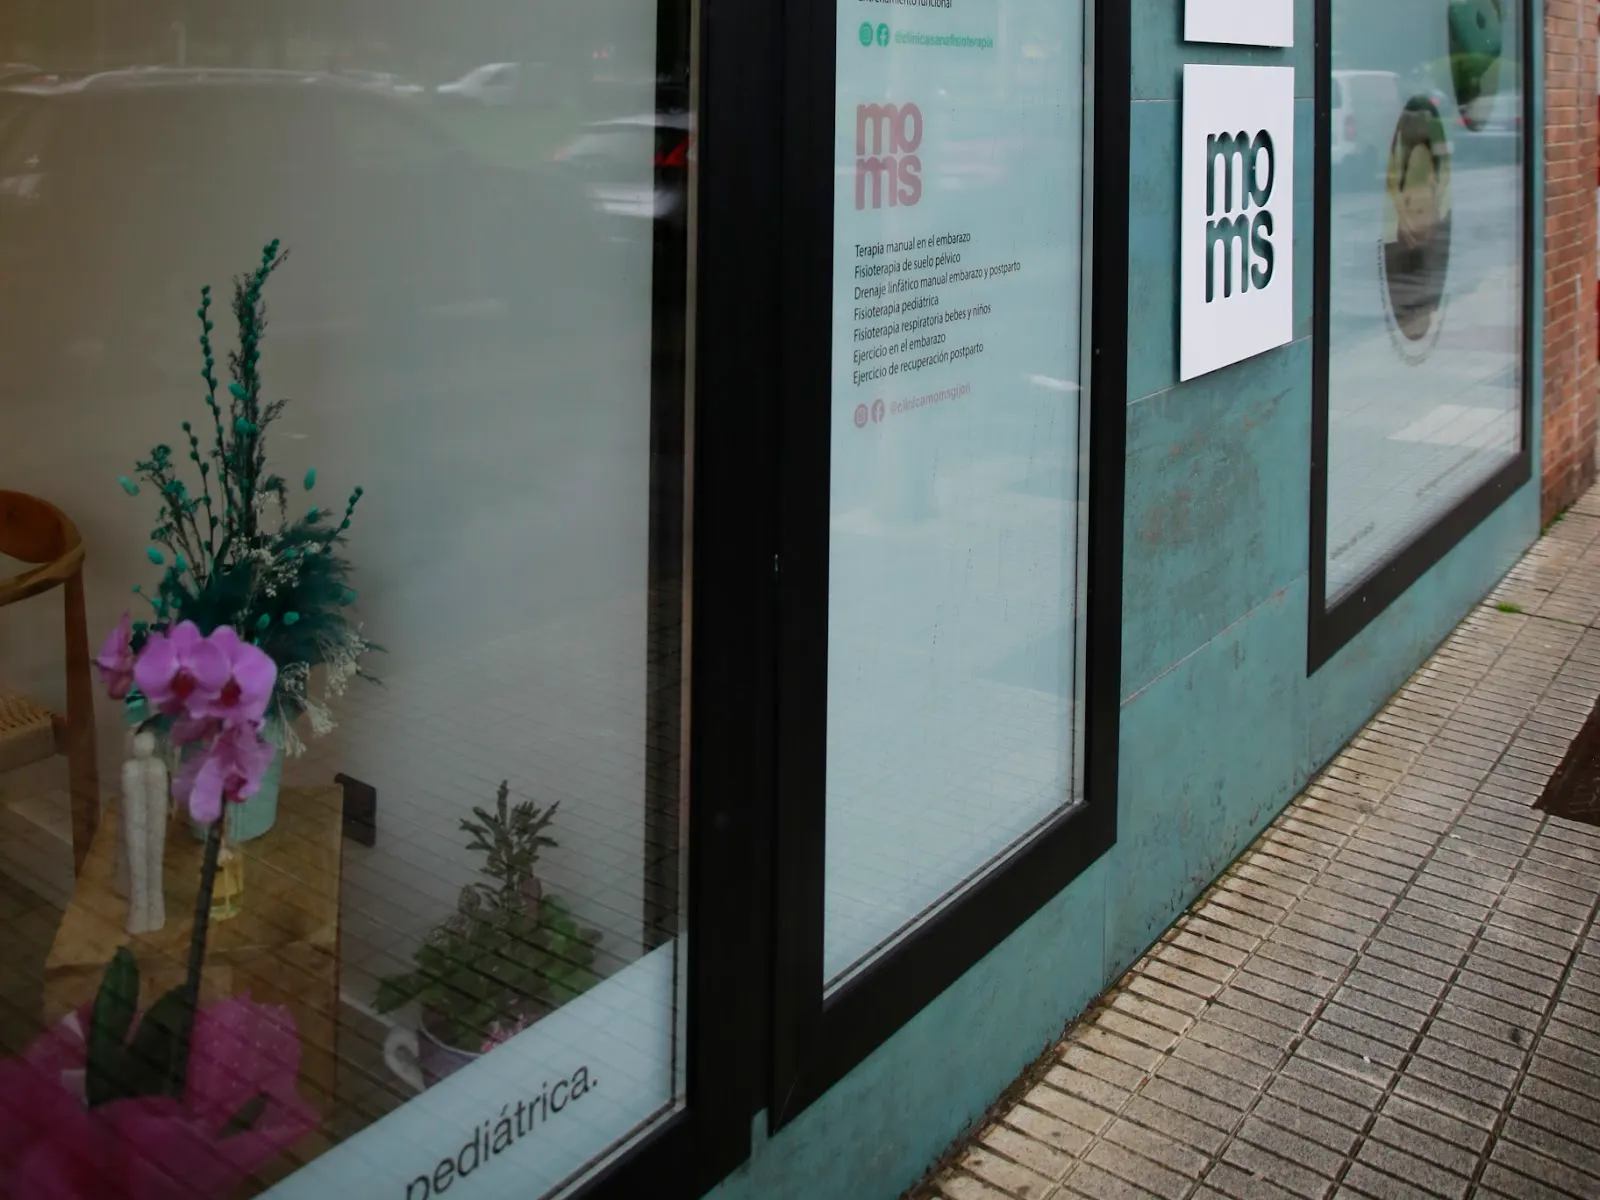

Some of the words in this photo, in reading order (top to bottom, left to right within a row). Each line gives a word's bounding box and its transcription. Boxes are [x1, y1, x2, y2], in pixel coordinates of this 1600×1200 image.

[857, 102, 923, 156] mo
[856, 155, 922, 211] ms
[1206, 129, 1275, 216] mo
[854, 261, 901, 279] Fisioterapia
[902, 258, 912, 272] de
[914, 254, 934, 270] suelo
[935, 251, 961, 270] pélvico
[855, 242, 885, 259] Terapia
[886, 236, 915, 253] manual
[917, 237, 927, 249] en
[928, 235, 935, 248] el
[936, 231, 971, 247] embarazo
[1206, 210, 1274, 303] ms
[854, 283, 886, 301] Drenaje
[888, 278, 919, 294] linfático
[920, 273, 948, 288] manual
[949, 268, 983, 284] embarazo
[989, 260, 1021, 276] postparto
[854, 303, 900, 321] Fisioterapia
[901, 295, 939, 313] pediátrica
[854, 323, 899, 342] Fisioterapia
[901, 312, 943, 333] respiratoria
[973, 303, 992, 316] niños
[853, 346, 887, 365] Ejercicio
[889, 343, 899, 355] en
[900, 338, 908, 352] el
[909, 332, 946, 350] embarazo
[853, 366, 887, 387] Ejercicio
[888, 362, 899, 375] de
[900, 350, 949, 373] recuperación
[950, 342, 984, 362] postparto
